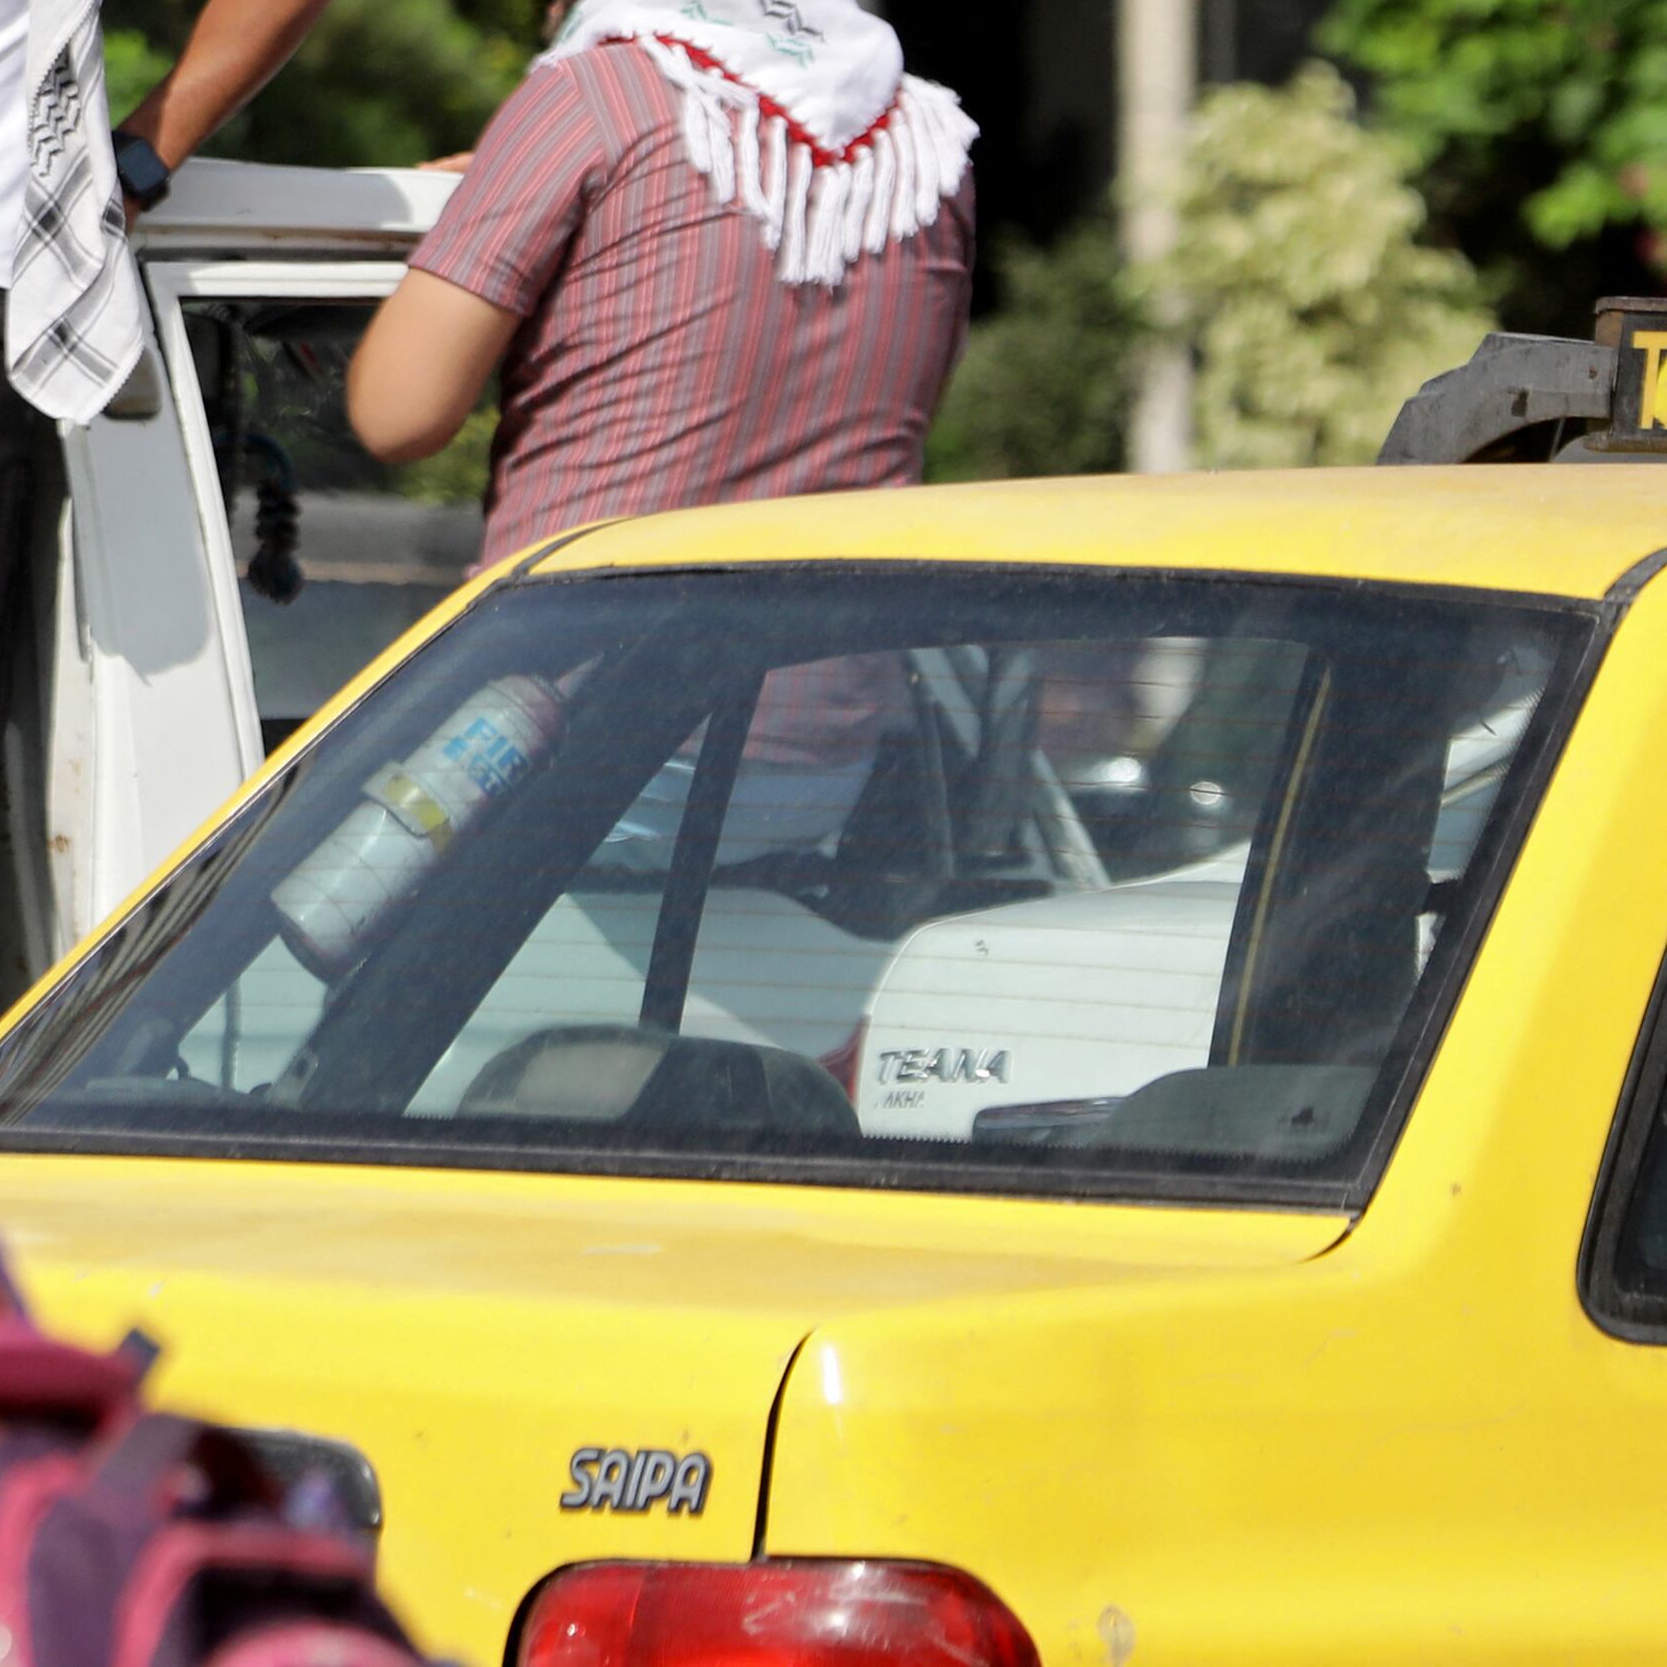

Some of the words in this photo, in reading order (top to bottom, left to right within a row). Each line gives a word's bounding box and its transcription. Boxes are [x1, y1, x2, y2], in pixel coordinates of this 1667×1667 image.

[1631, 330, 1667, 430] T
[879, 1047, 1013, 1084] TEANA
[560, 1446, 711, 1513] SAIPA
